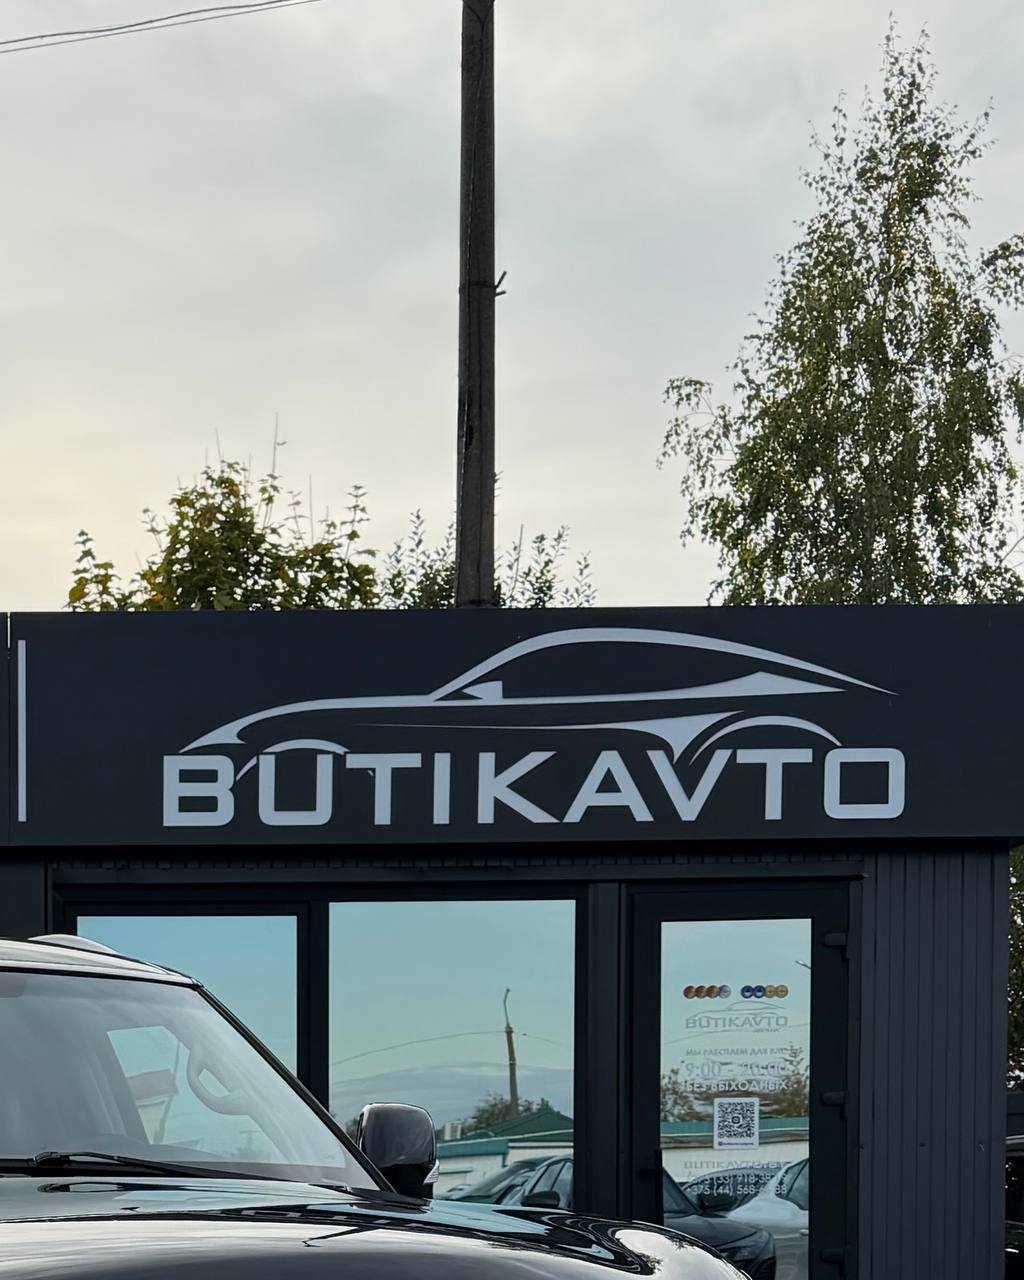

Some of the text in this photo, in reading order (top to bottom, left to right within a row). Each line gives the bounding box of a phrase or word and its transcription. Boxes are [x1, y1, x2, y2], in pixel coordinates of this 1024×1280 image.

[163, 747, 906, 827] BUTIKAVTO
[685, 1016, 788, 1029] BUTIKAVTO
[685, 1062, 721, 1078] 9:00
